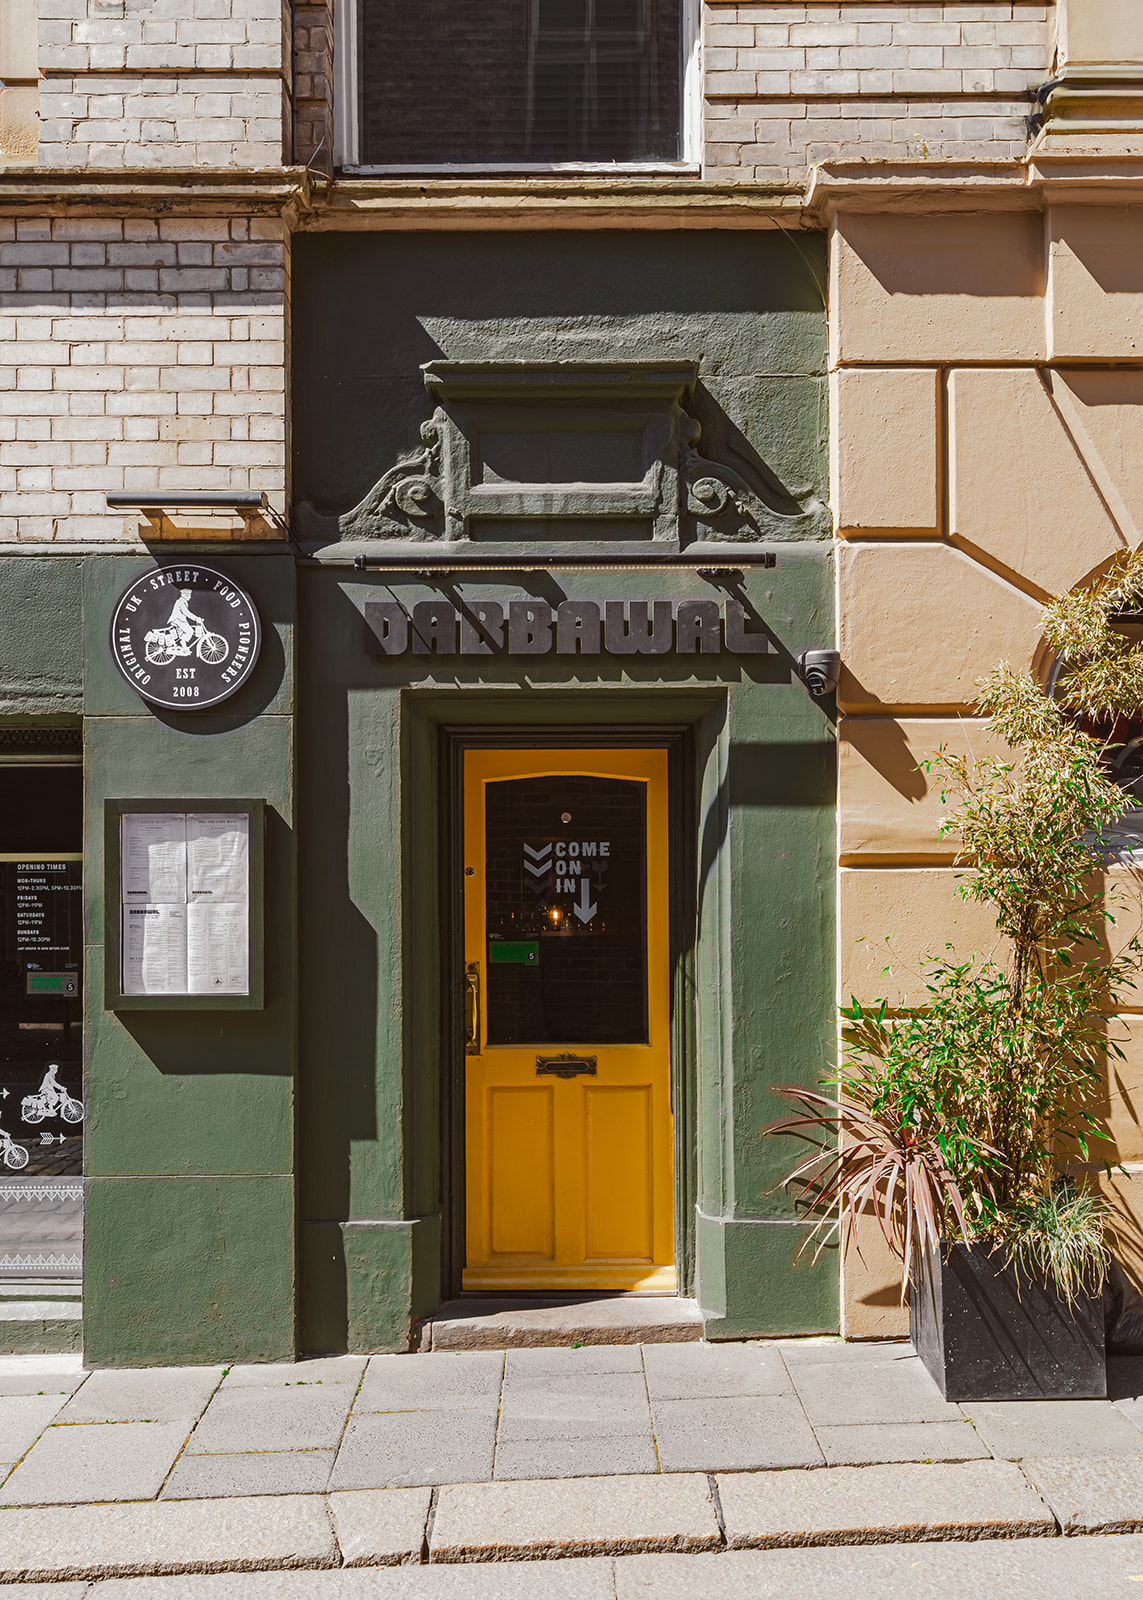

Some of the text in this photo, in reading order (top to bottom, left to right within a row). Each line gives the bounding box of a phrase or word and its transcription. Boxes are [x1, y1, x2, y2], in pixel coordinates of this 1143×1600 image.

[119, 570, 250, 686] ORIGINAL UK STREET FOOD PIONEERS
[365, 600, 770, 655] DABBAWAL
[175, 668, 196, 679] EST
[173, 686, 200, 697] 2008
[555, 841, 610, 857] COME
[555, 860, 582, 876] ON
[555, 878, 576, 894] IN
